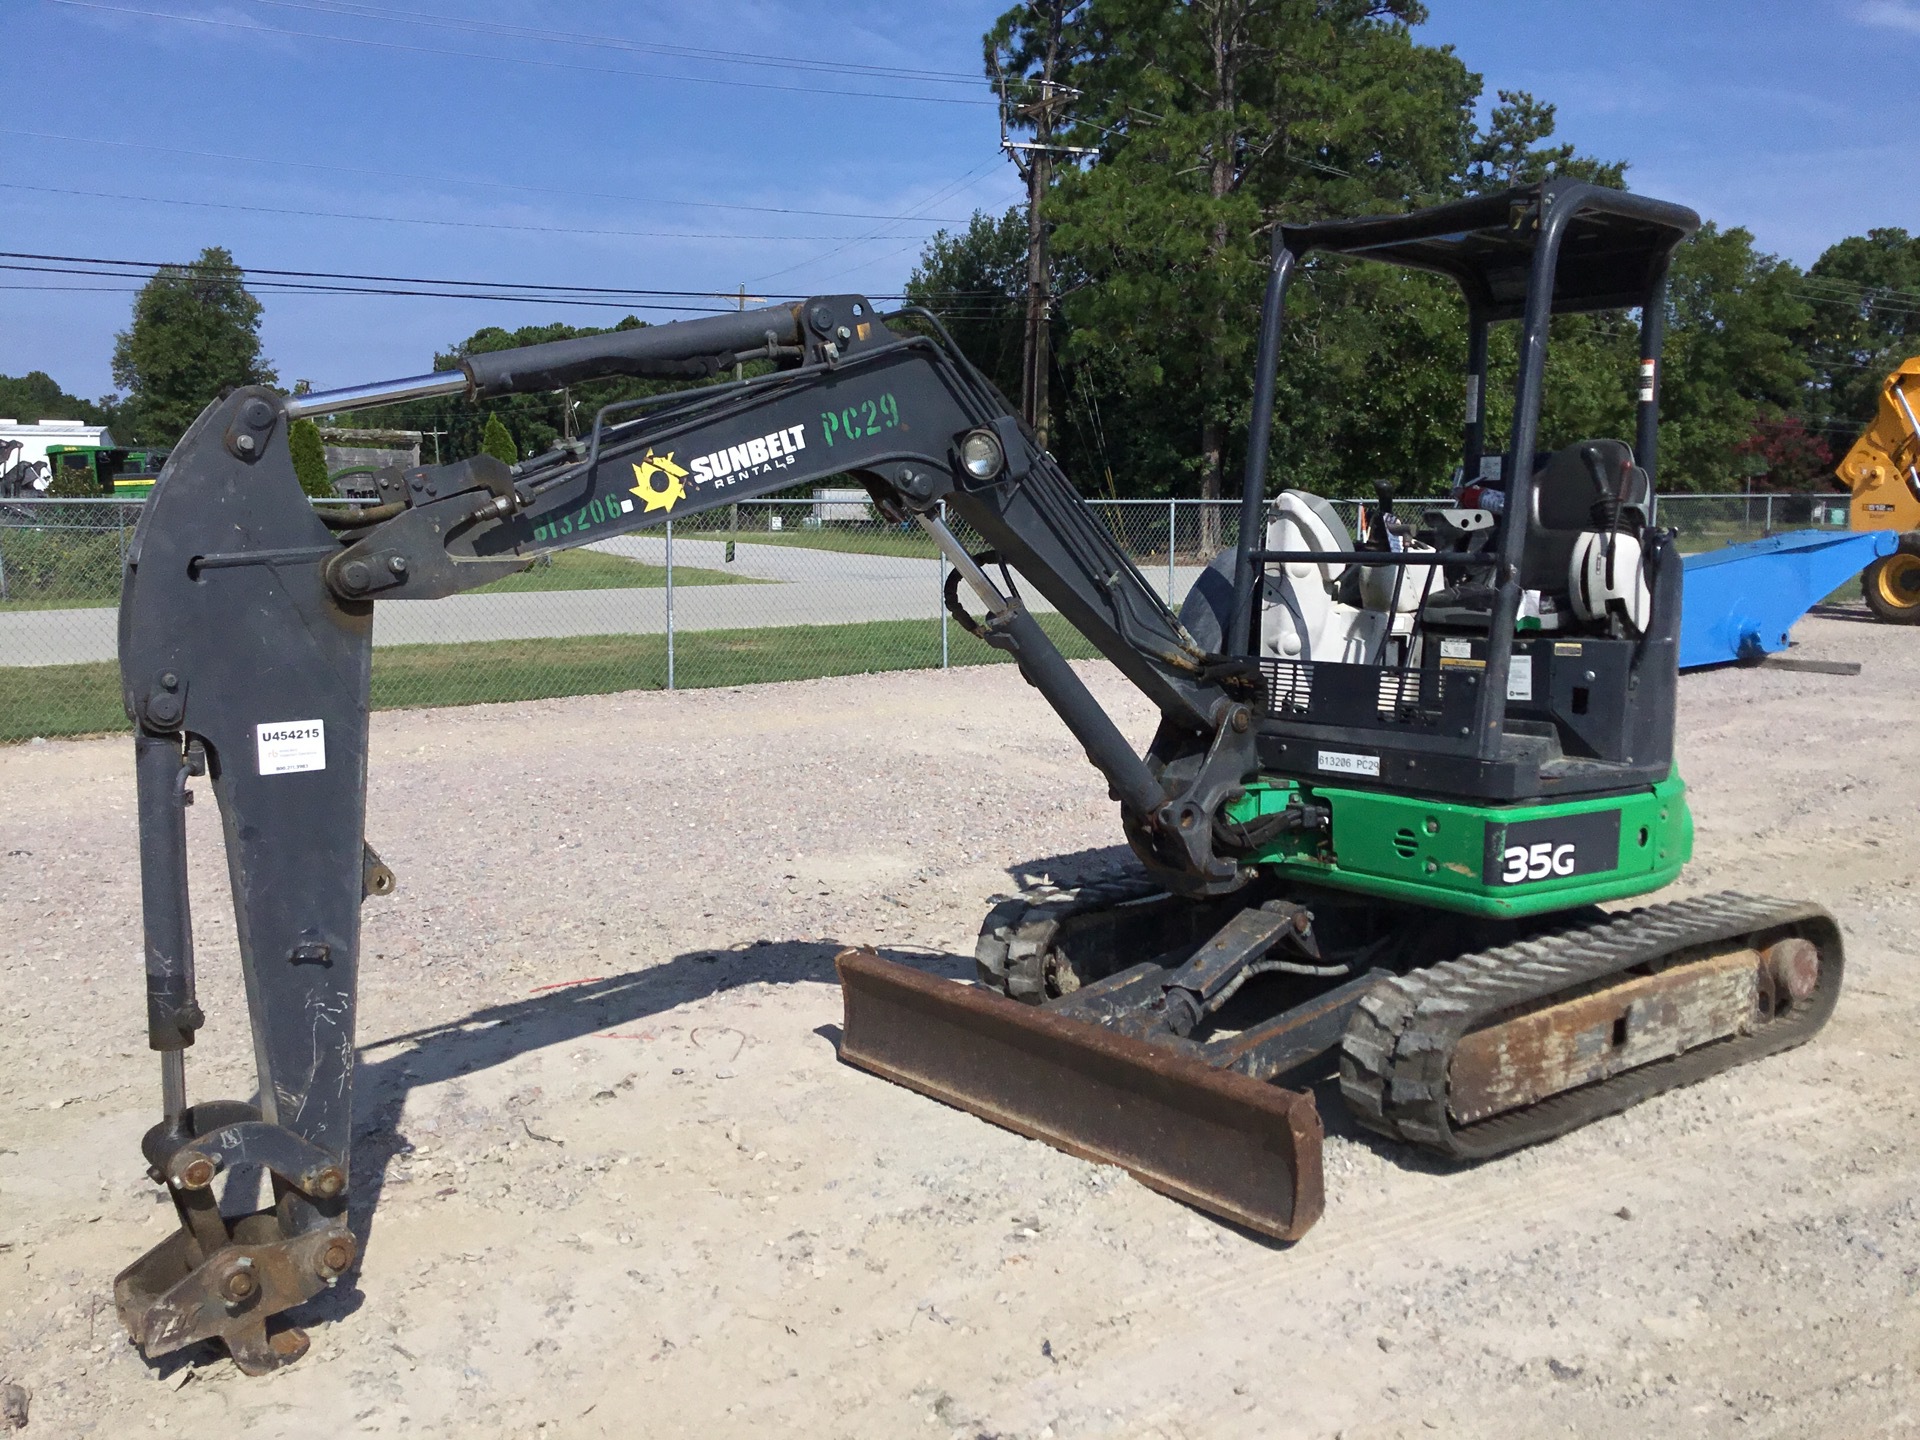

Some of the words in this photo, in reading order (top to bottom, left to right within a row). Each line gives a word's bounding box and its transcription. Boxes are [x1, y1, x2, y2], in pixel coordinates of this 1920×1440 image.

[820, 392, 900, 447] PC29
[689, 423, 806, 485] SUNBELT
[713, 454, 796, 490] RENTALS
[262, 728, 319, 742] U454215
[1318, 755, 1352, 769] 613206
[1356, 759, 1380, 771] PC29
[1502, 842, 1575, 883] 35G
